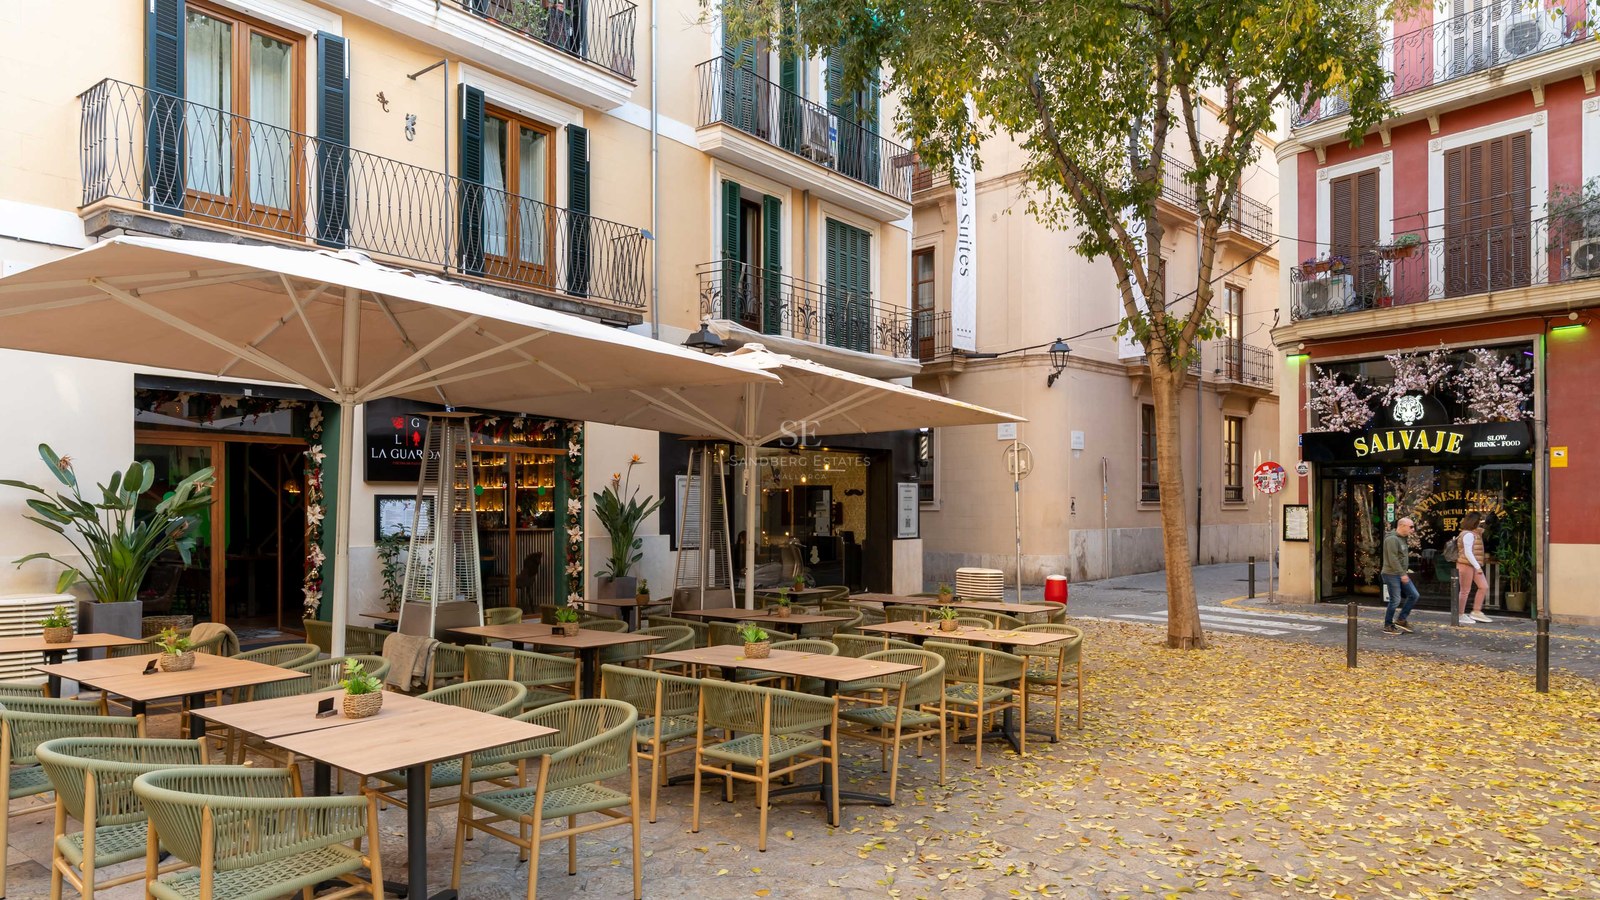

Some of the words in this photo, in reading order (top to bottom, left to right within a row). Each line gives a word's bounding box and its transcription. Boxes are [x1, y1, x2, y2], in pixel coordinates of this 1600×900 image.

[958, 213, 971, 277] Suites
[411, 417, 420, 428] G
[395, 434, 402, 445] L
[1353, 430, 1464, 457] SALVAJE
[371, 447, 387, 459] LA
